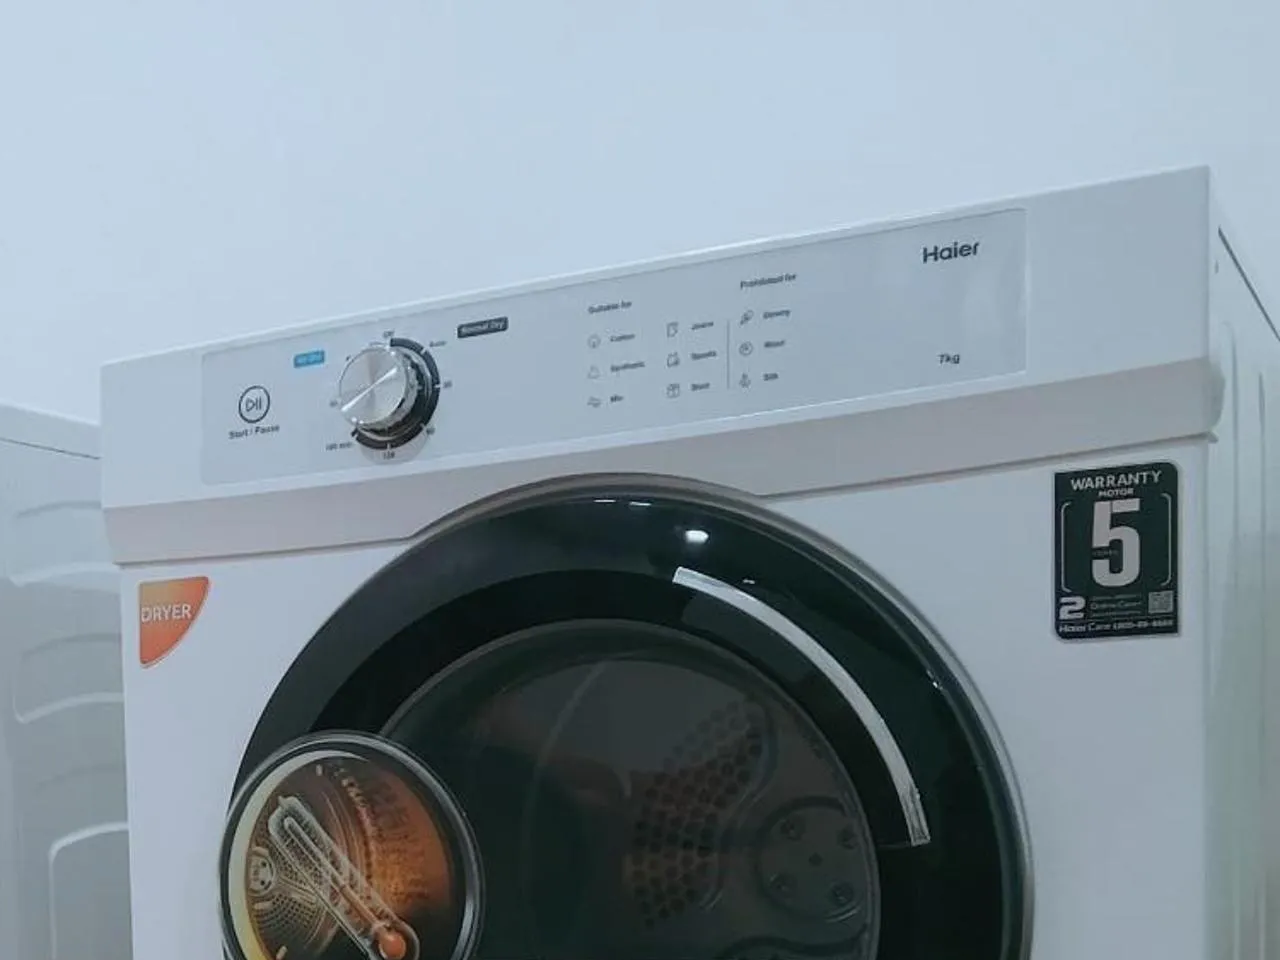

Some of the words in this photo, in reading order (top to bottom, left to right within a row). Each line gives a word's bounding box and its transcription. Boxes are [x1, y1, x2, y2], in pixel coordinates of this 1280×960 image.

[922, 241, 980, 263] Haier
[228, 429, 249, 440] Start
[255, 425, 280, 435] Pause
[1070, 470, 1163, 491] WARRANTY
[1091, 498, 1141, 587] 5
[140, 603, 194, 623] DRYER
